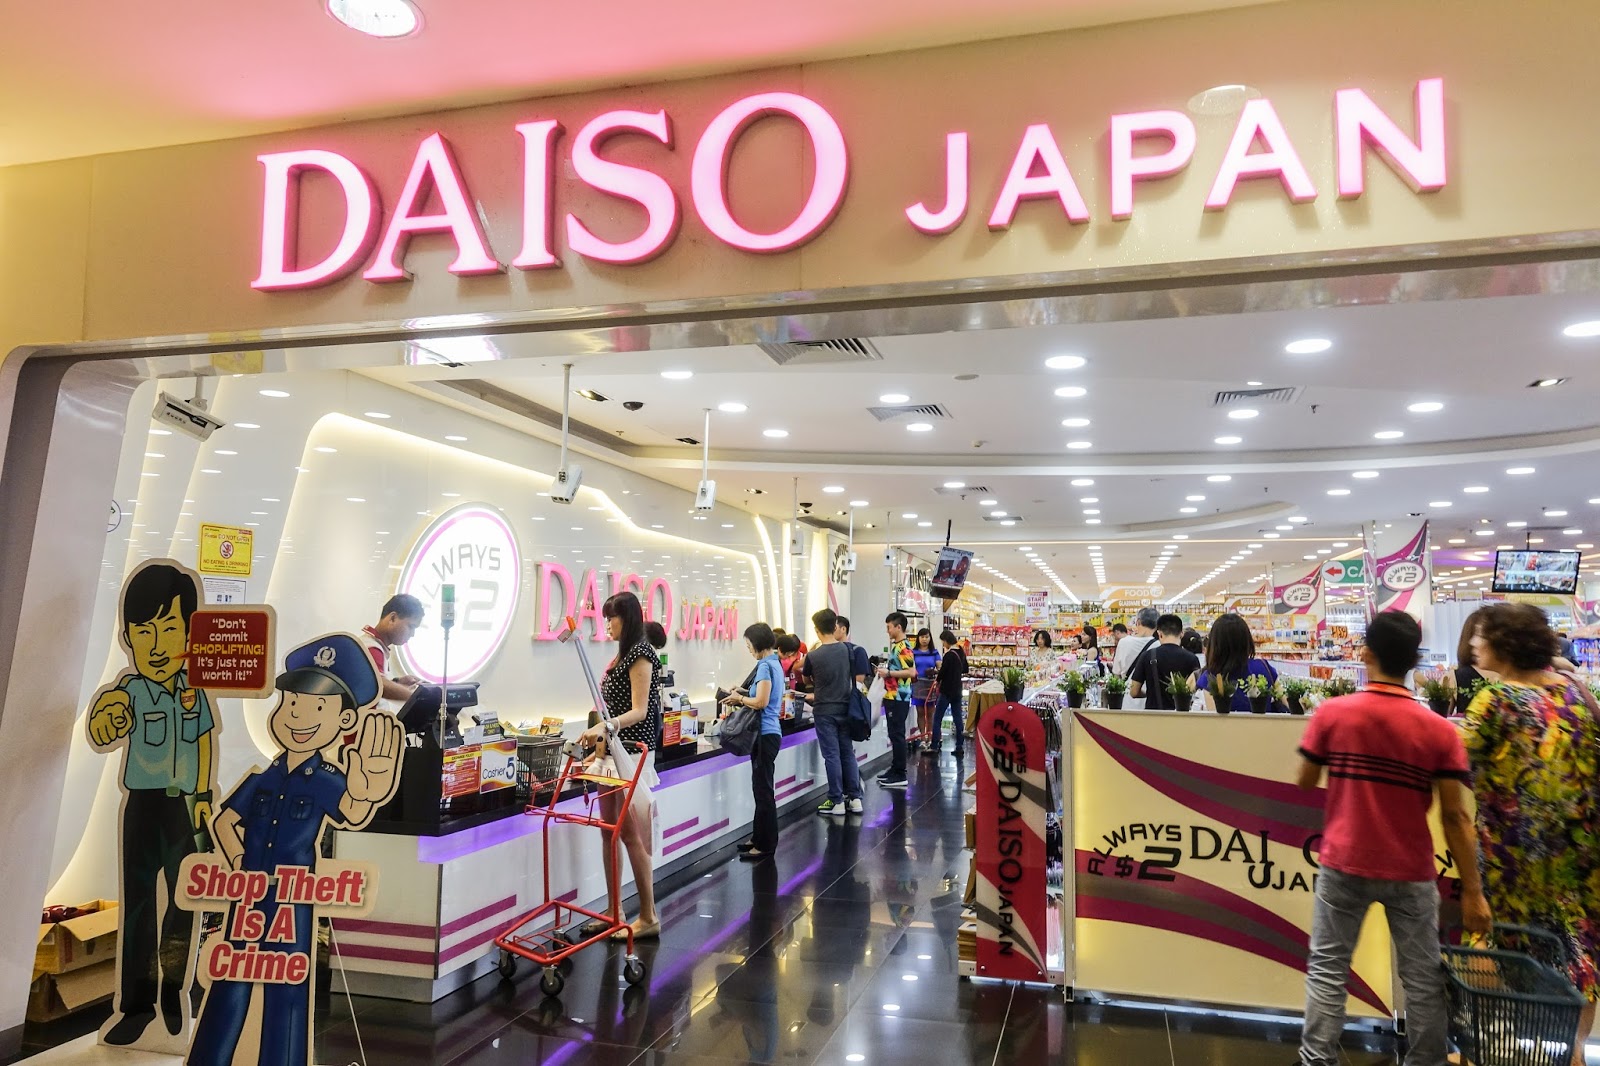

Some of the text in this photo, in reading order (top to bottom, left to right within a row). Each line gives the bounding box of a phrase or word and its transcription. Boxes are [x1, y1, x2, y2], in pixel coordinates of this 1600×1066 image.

[250, 78, 1447, 292] DAISO JAPAN
[1387, 565, 1417, 583] ALWAYS
[1396, 572, 1417, 583] $2
[532, 561, 739, 642] DAO JAPAN
[1125, 589, 1150, 597] FOOD
[1286, 587, 1311, 601] ALWAYS
[1294, 592, 1311, 602] $2
[192, 643, 265, 655] SHOPLIFTING!
[209, 631, 249, 642] commit
[197, 656, 258, 670] It's just not
[202, 670, 232, 681] worth
[993, 718, 1027, 774] ALWAYS
[993, 733, 1014, 773] $2
[482, 767, 506, 779] Cashier
[505, 756, 516, 780] 5
[1087, 823, 1182, 877] ALWAYS
[1114, 845, 1182, 882] $2
[998, 780, 1022, 956] DAISO JAPAN
[187, 863, 363, 906] Shop Theft
[232, 905, 264, 939] Is
[269, 906, 294, 941] A
[209, 943, 308, 982] Crime
